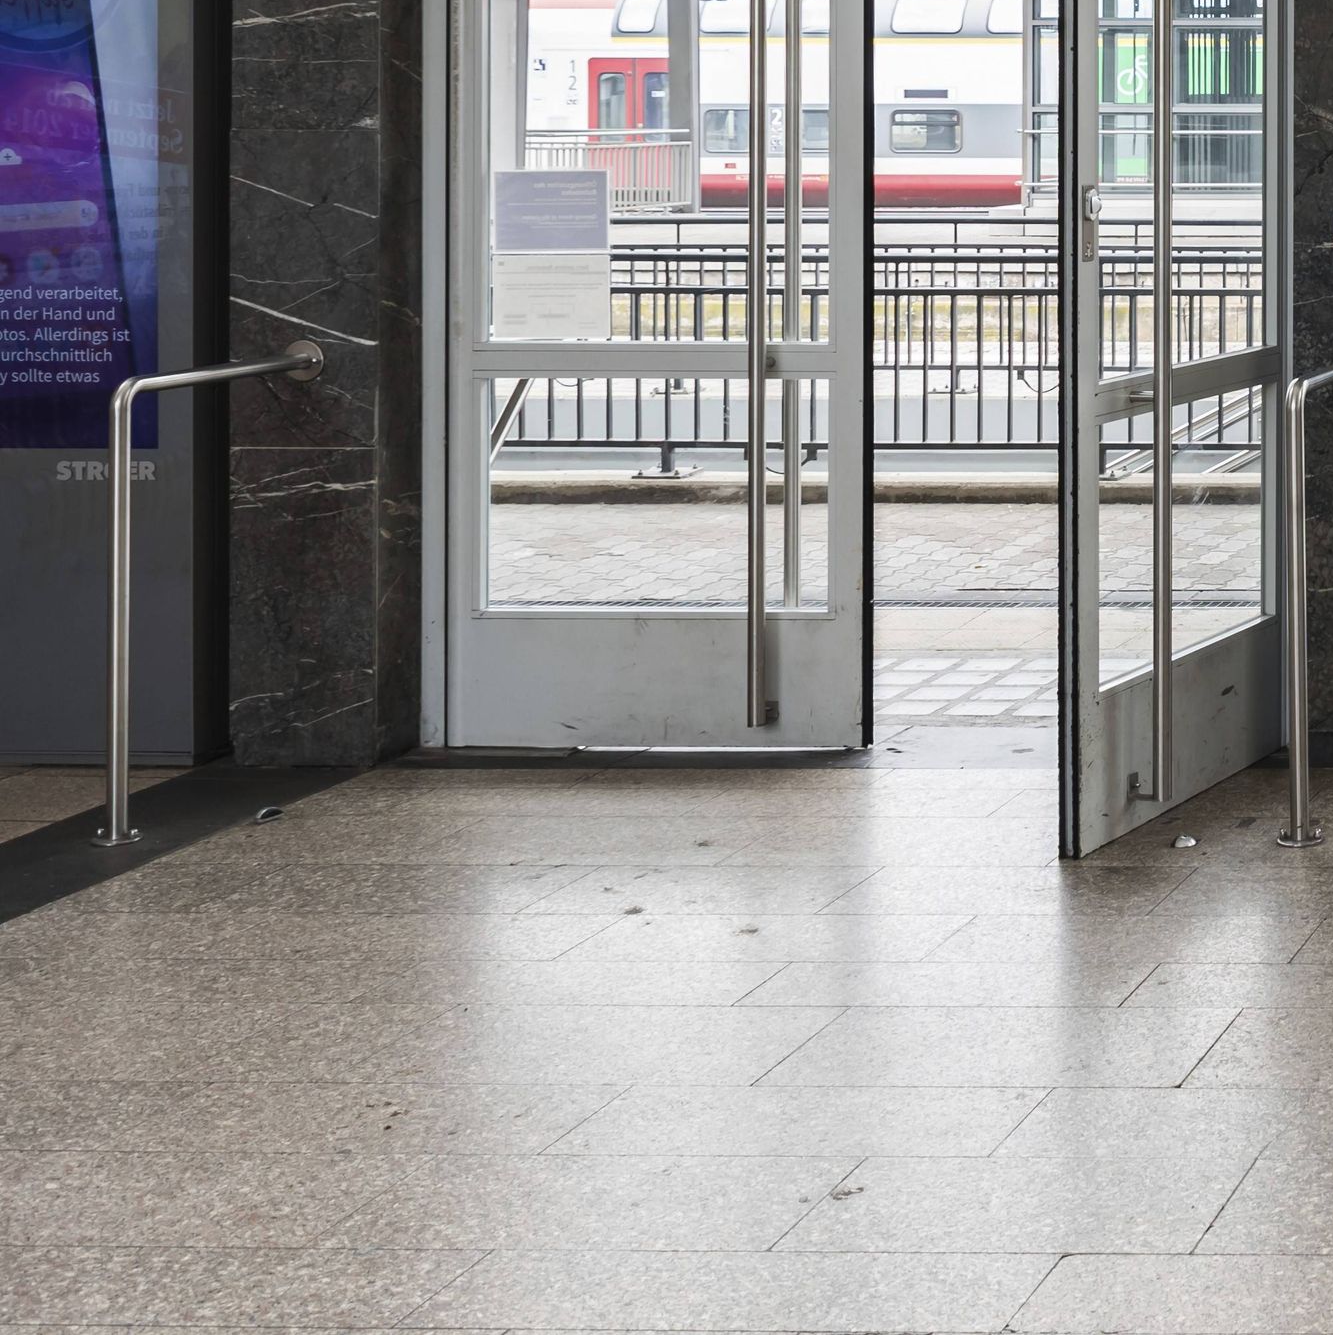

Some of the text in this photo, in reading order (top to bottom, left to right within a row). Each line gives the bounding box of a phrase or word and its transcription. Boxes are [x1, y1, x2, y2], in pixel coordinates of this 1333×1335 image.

[568, 75, 577, 90] 2
[771, 109, 782, 125] 2
[36, 286, 123, 301] verarbeitet,
[14, 306, 39, 320] der
[42, 307, 82, 320] Hand
[87, 307, 115, 320] und
[34, 328, 108, 345] Allerdings
[113, 329, 130, 341] ist
[11, 370, 52, 383] sollte
[56, 371, 100, 383] etwas
[56, 461, 155, 481] STRER
